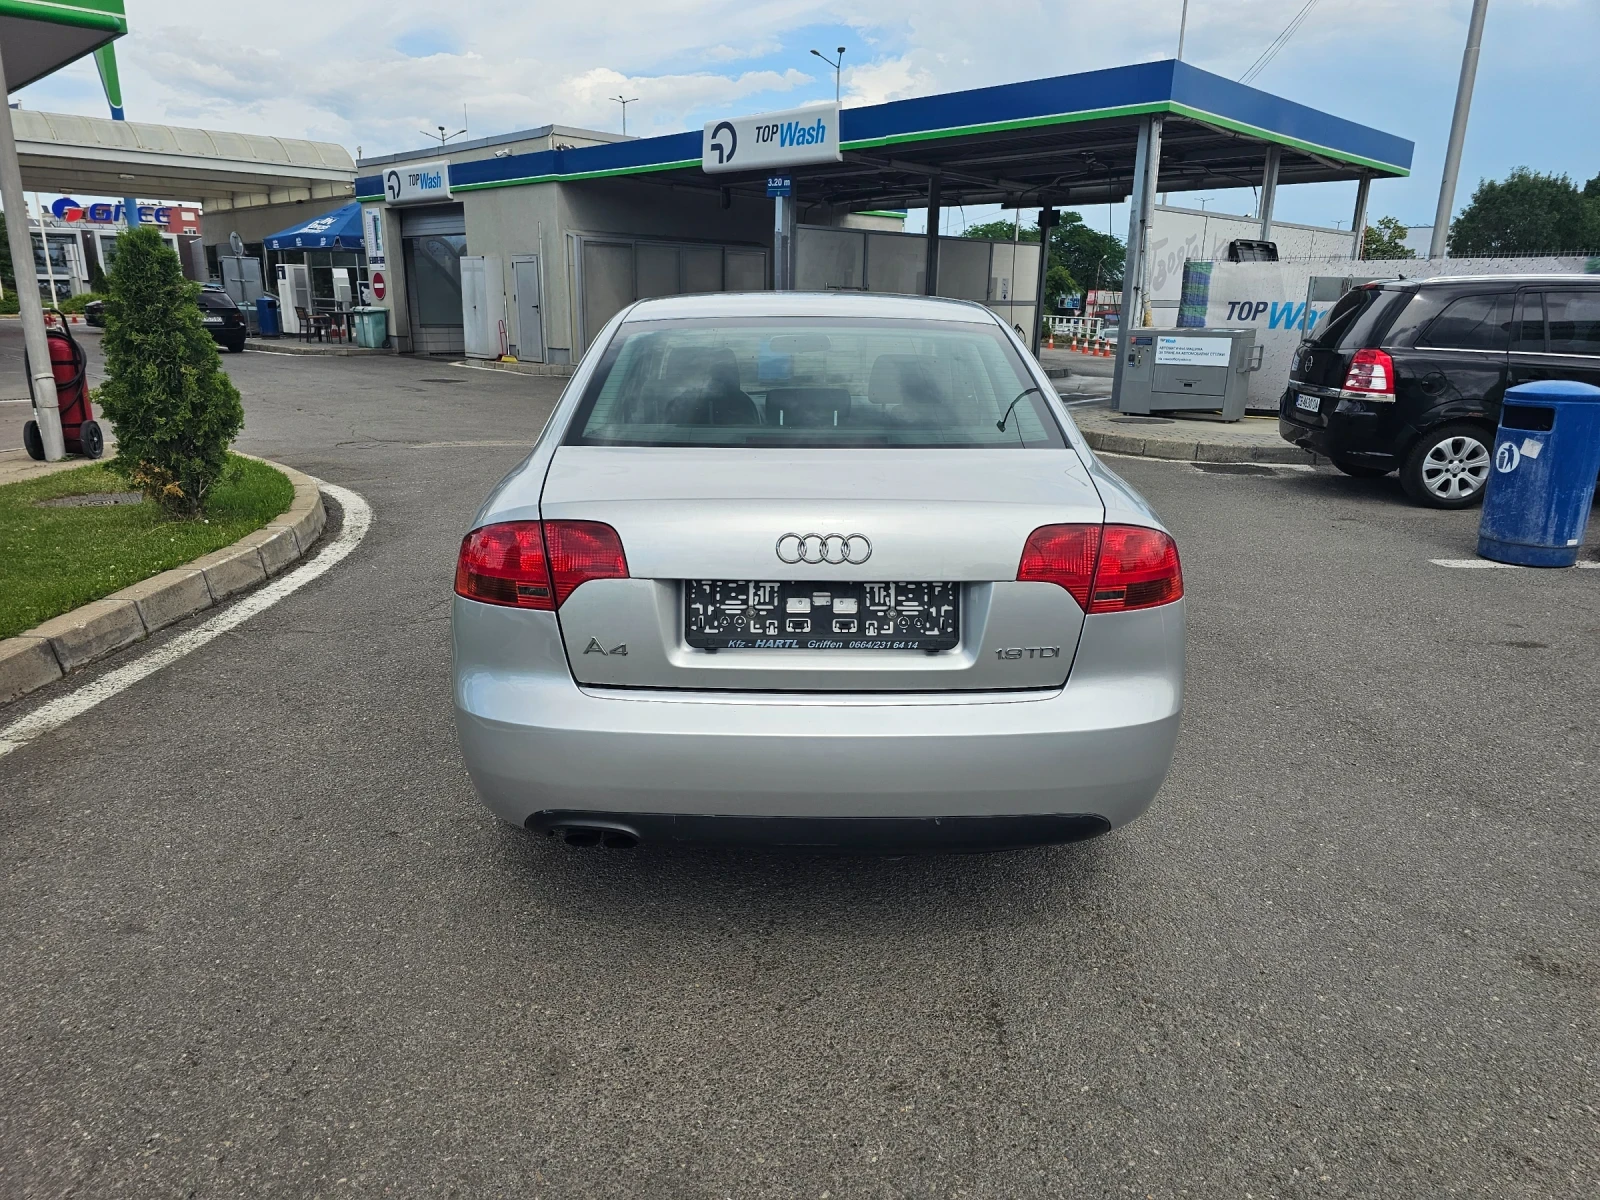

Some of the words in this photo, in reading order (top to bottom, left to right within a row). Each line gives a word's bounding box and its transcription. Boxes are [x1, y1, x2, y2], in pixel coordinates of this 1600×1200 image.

[767, 178, 783, 187] 3.20
[1268, 301, 1328, 330] Wa
[583, 635, 628, 657] A4
[728, 639, 745, 648] Kfz
[755, 639, 799, 648] HARTL
[807, 640, 843, 649] Griffen
[849, 640, 891, 649] 0664/231
[893, 640, 906, 649] 64
[907, 640, 919, 649] 14
